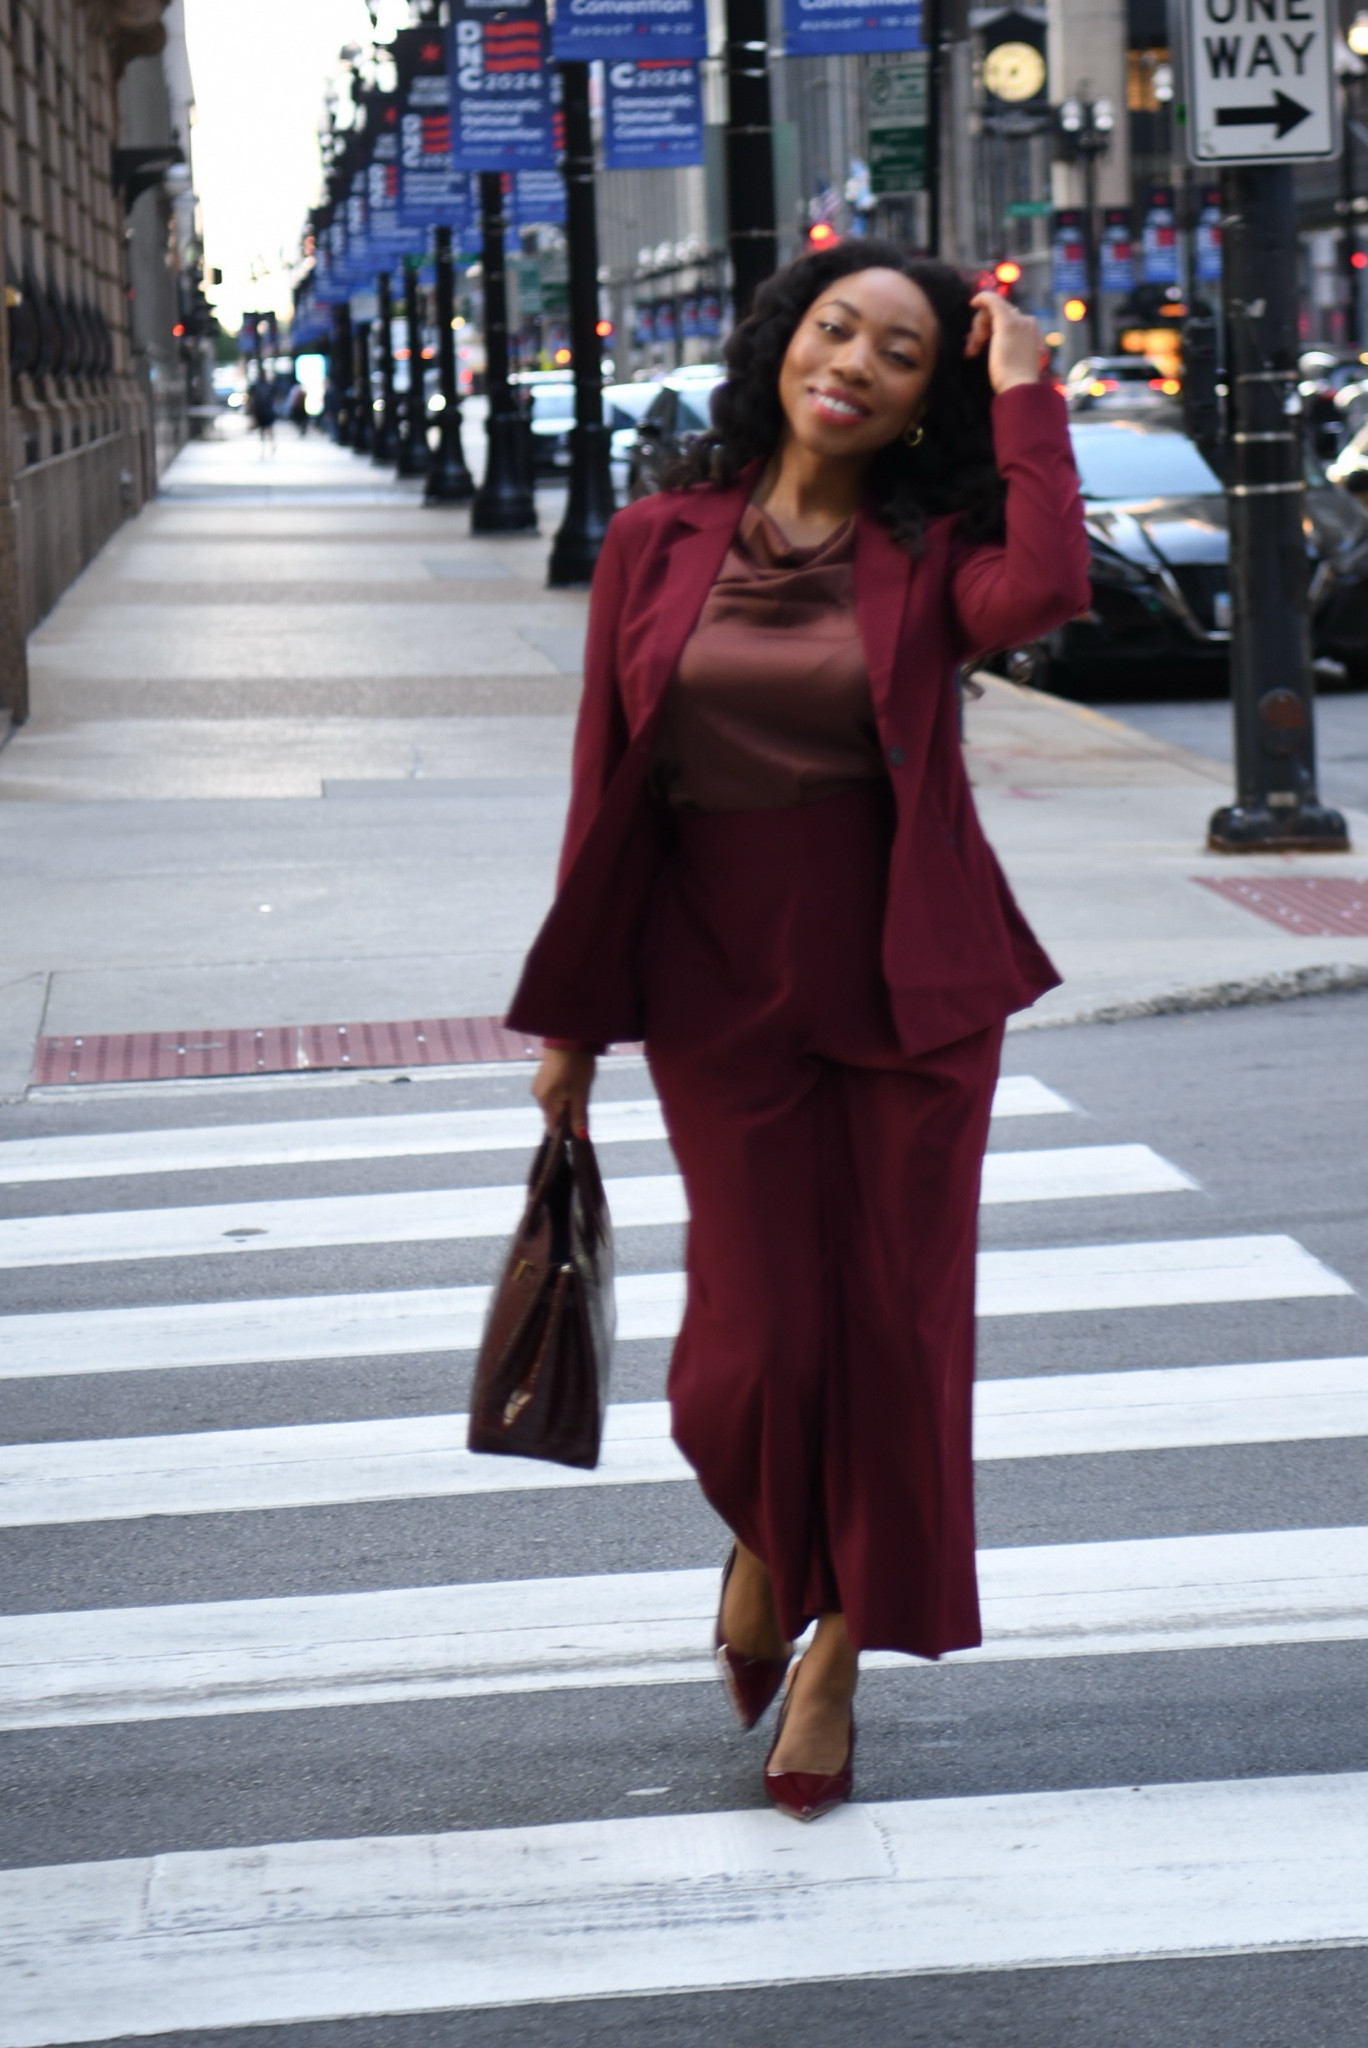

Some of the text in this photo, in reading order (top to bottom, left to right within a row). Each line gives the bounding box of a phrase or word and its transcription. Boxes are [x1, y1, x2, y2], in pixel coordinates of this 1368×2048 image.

[1204, 31, 1316, 79] WAY
[484, 71, 543, 91] 2024
[637, 68, 694, 88] 2024
